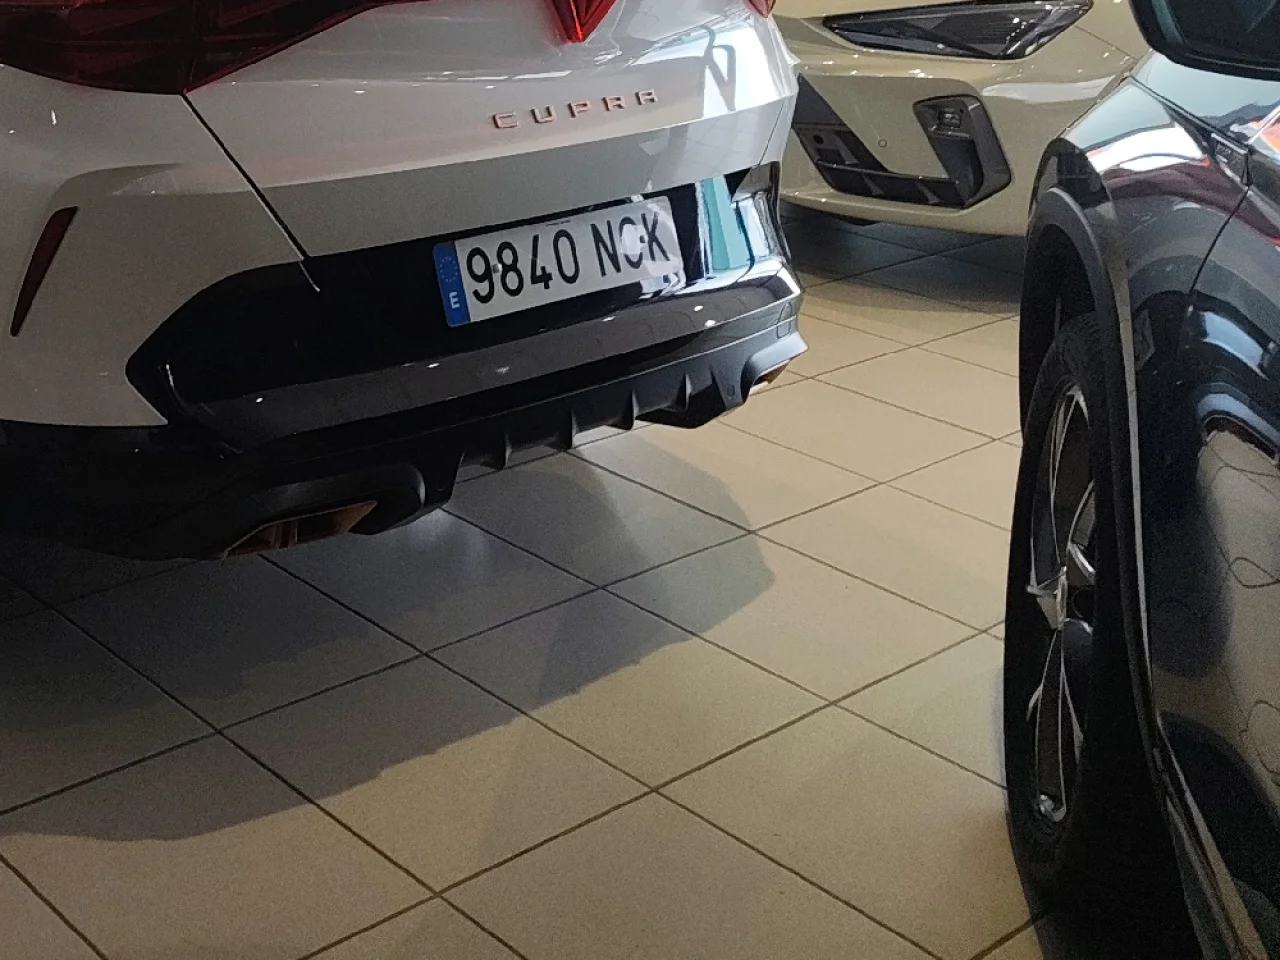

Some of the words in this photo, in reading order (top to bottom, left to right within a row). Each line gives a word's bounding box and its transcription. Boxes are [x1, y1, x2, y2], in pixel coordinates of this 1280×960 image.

[492, 88, 659, 128] CUPRA
[466, 229, 580, 304] 9840
[448, 291, 461, 309] E
